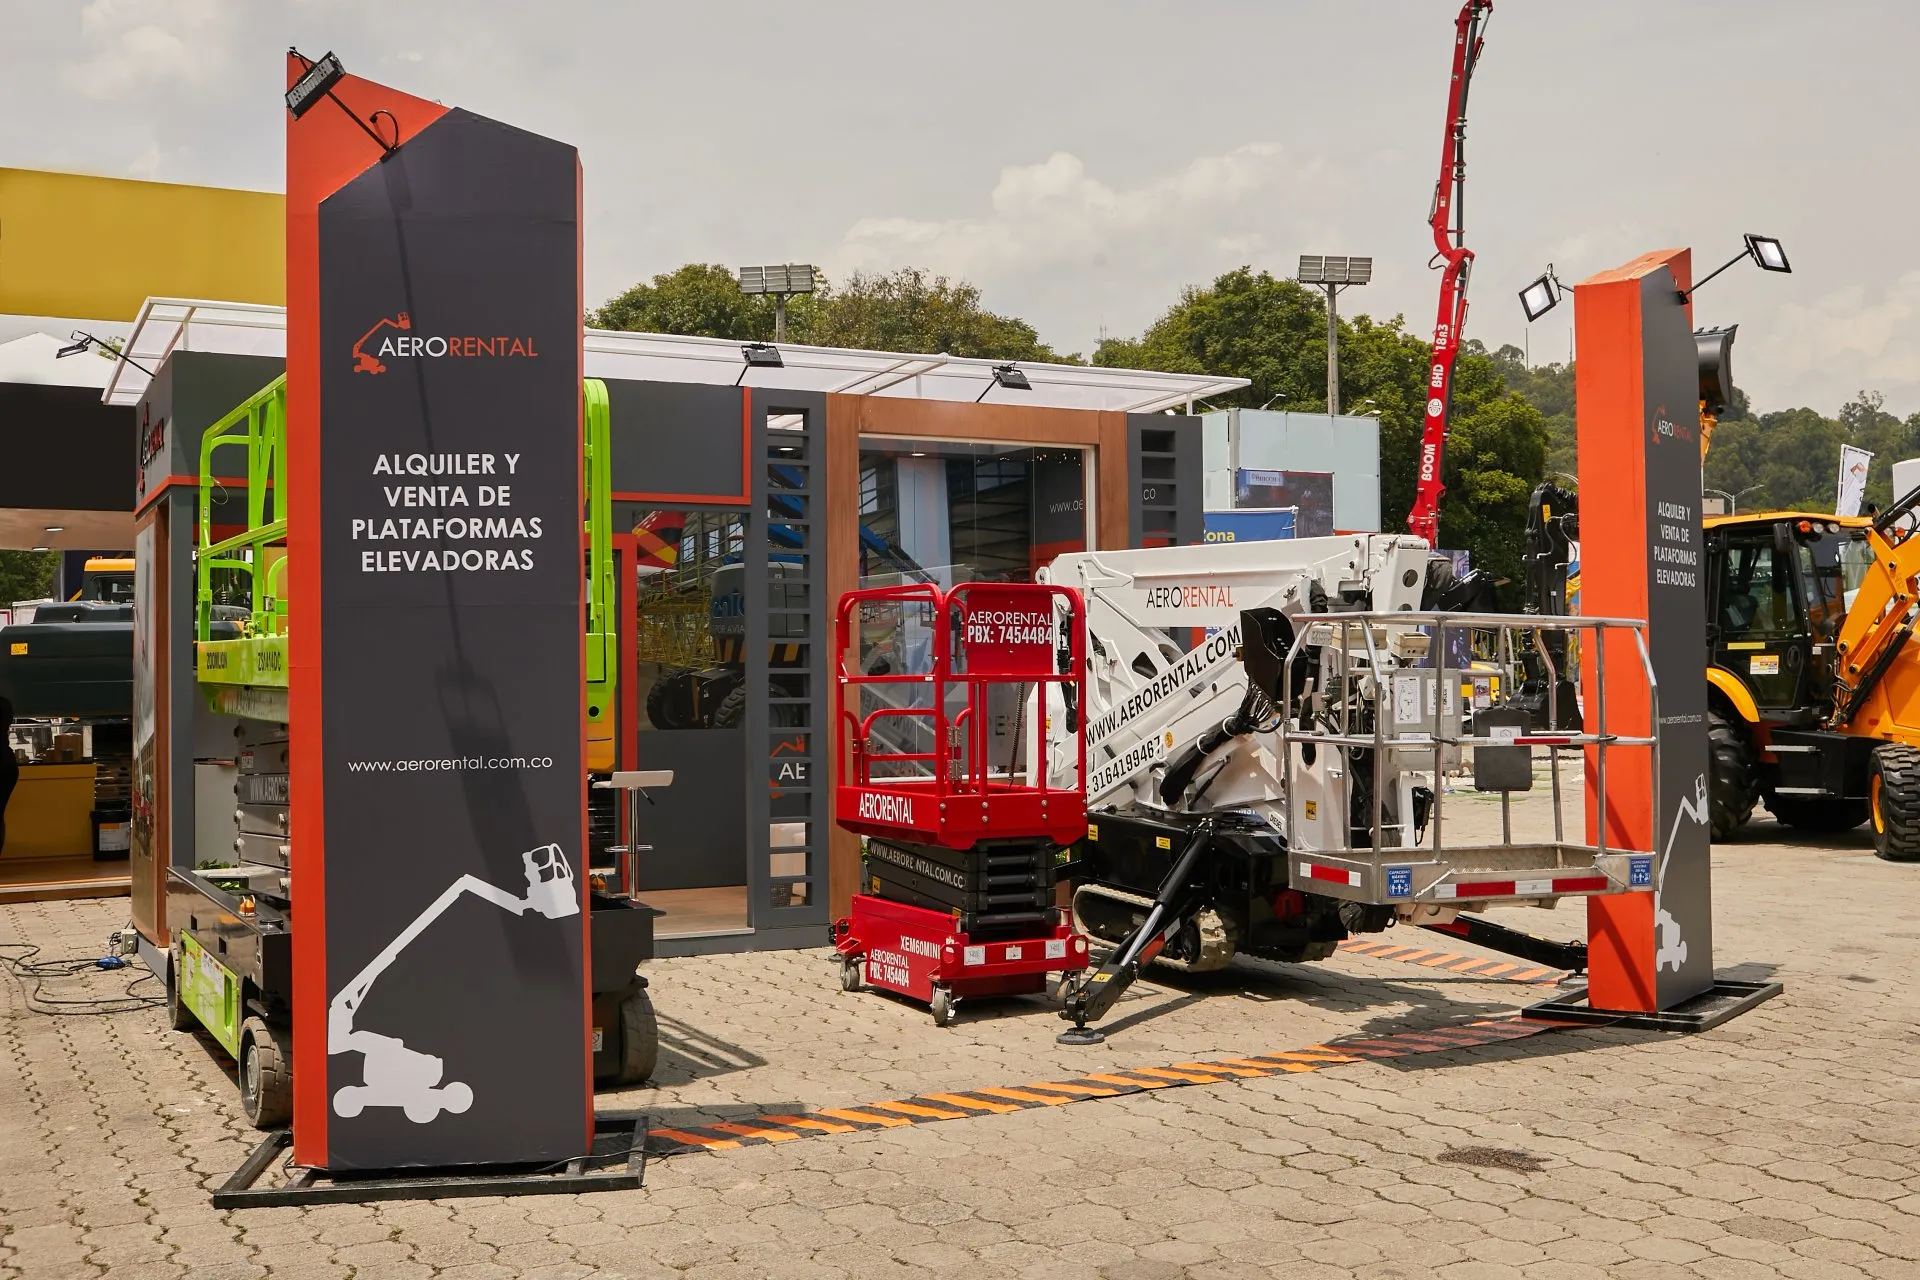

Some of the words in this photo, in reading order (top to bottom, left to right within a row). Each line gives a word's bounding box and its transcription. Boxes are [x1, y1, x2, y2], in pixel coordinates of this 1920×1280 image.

[378, 336, 538, 358] AERORENTAL
[1421, 444, 1436, 482] BOOM
[1431, 363, 1444, 388] BHD
[373, 453, 496, 476] ALQUILER
[504, 453, 520, 475] Y
[384, 486, 469, 507] VENTA
[478, 485, 511, 507] DE
[1658, 501, 1686, 521] ALQUILER
[1686, 506, 1691, 522] Y
[352, 517, 543, 540] PLATAFORMAS
[1204, 530, 1235, 542] ona
[1660, 523, 1680, 542] VENTA
[1681, 527, 1690, 543] DE
[361, 549, 535, 572] ELEVADORAS
[1654, 545, 1697, 566] PLATAFORMAS
[1657, 568, 1696, 588] ELEVADORAS
[1146, 586, 1234, 608] AERORENTAL
[968, 611, 1053, 626] AERORENTAL
[967, 625, 995, 644] PBX:
[998, 626, 1053, 645] 7454484
[1086, 625, 1241, 748] WWW.AERORENTAL.COM
[348, 755, 553, 772] www.aerorental.com.co
[858, 792, 914, 825] AERORENTAL
[869, 948, 909, 969] AERORENTAL
[900, 935, 941, 960] XEM60MINI
[870, 960, 883, 980] PBX:
[883, 964, 909, 988] 7454484
